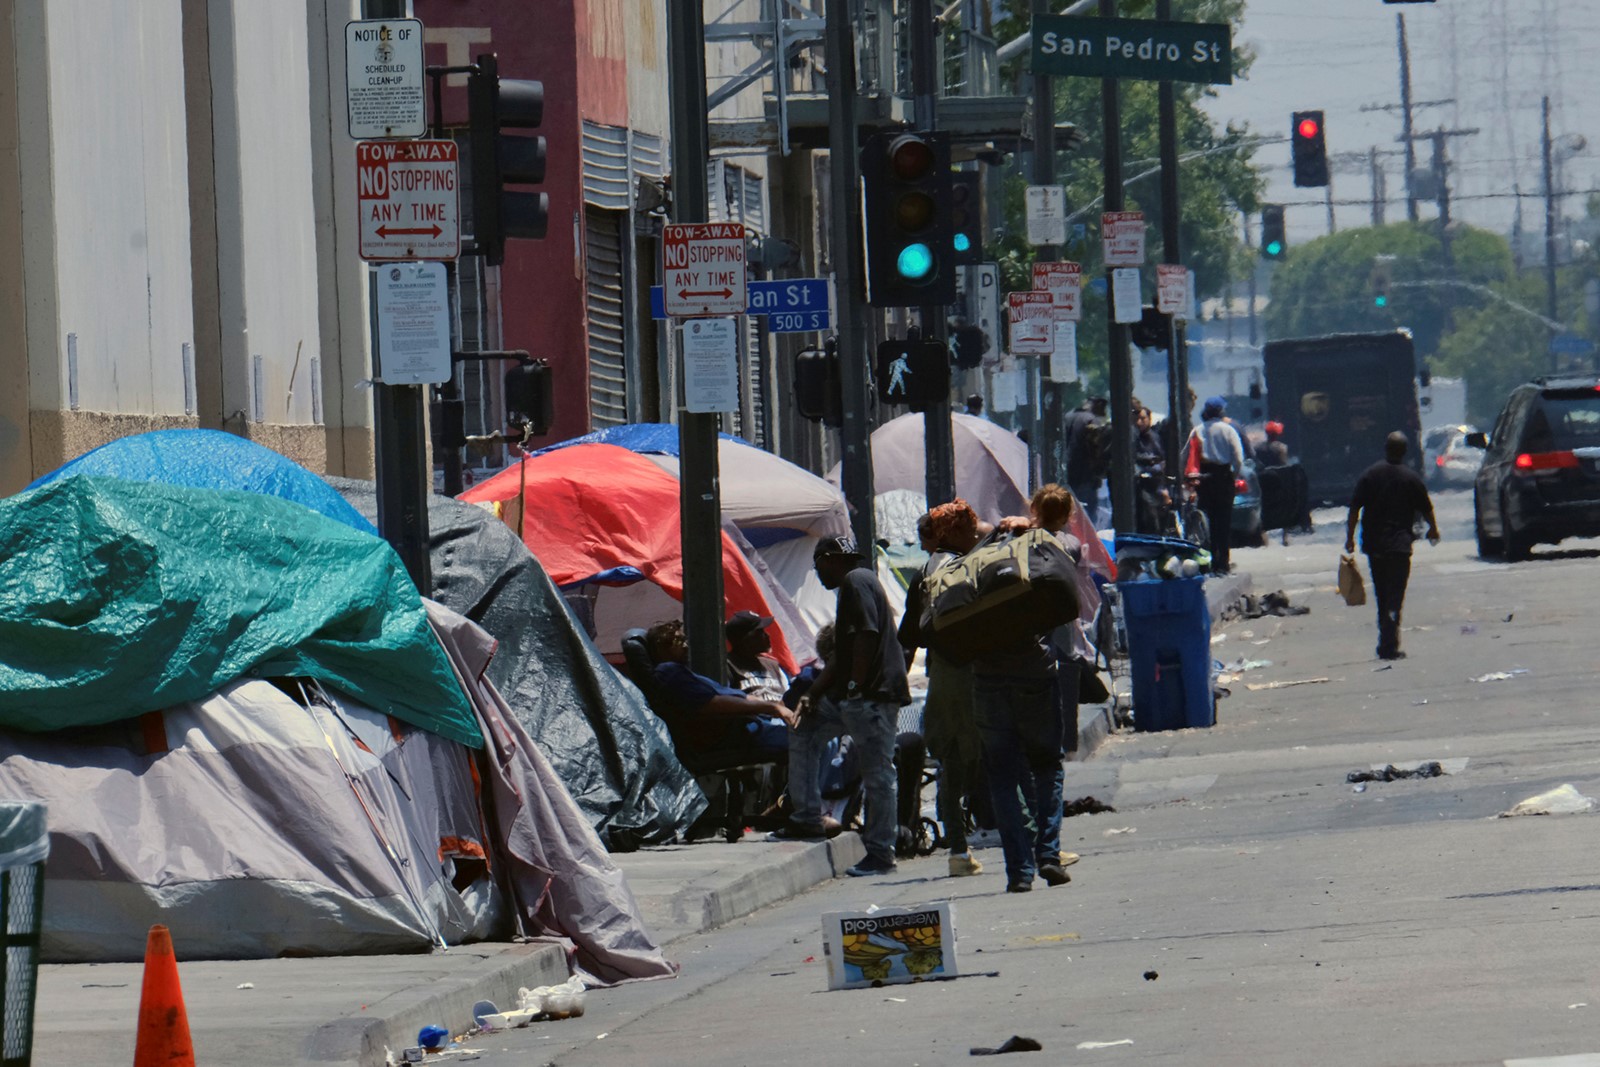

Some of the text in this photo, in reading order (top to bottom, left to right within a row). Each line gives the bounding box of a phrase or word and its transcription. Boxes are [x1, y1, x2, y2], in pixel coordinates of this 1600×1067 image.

[355, 28, 412, 42] NOTICE OF
[1040, 31, 1220, 63] San Pedro St
[365, 64, 406, 74] SCHEDULED
[368, 76, 403, 86] CLEAN-UP
[360, 144, 453, 160] TOW-AWAY
[360, 166, 454, 196] NO STOPPING
[371, 203, 446, 222] ANY TIME
[666, 225, 741, 239] TOW-AWAY
[665, 243, 742, 267] NO STOPPING
[675, 271, 736, 287] ANY TIME
[1034, 275, 1047, 290] NO
[747, 284, 811, 308] ian St
[776, 313, 820, 330] 500 S
[1010, 306, 1023, 321] NO
[843, 912, 939, 935] Western Gold
